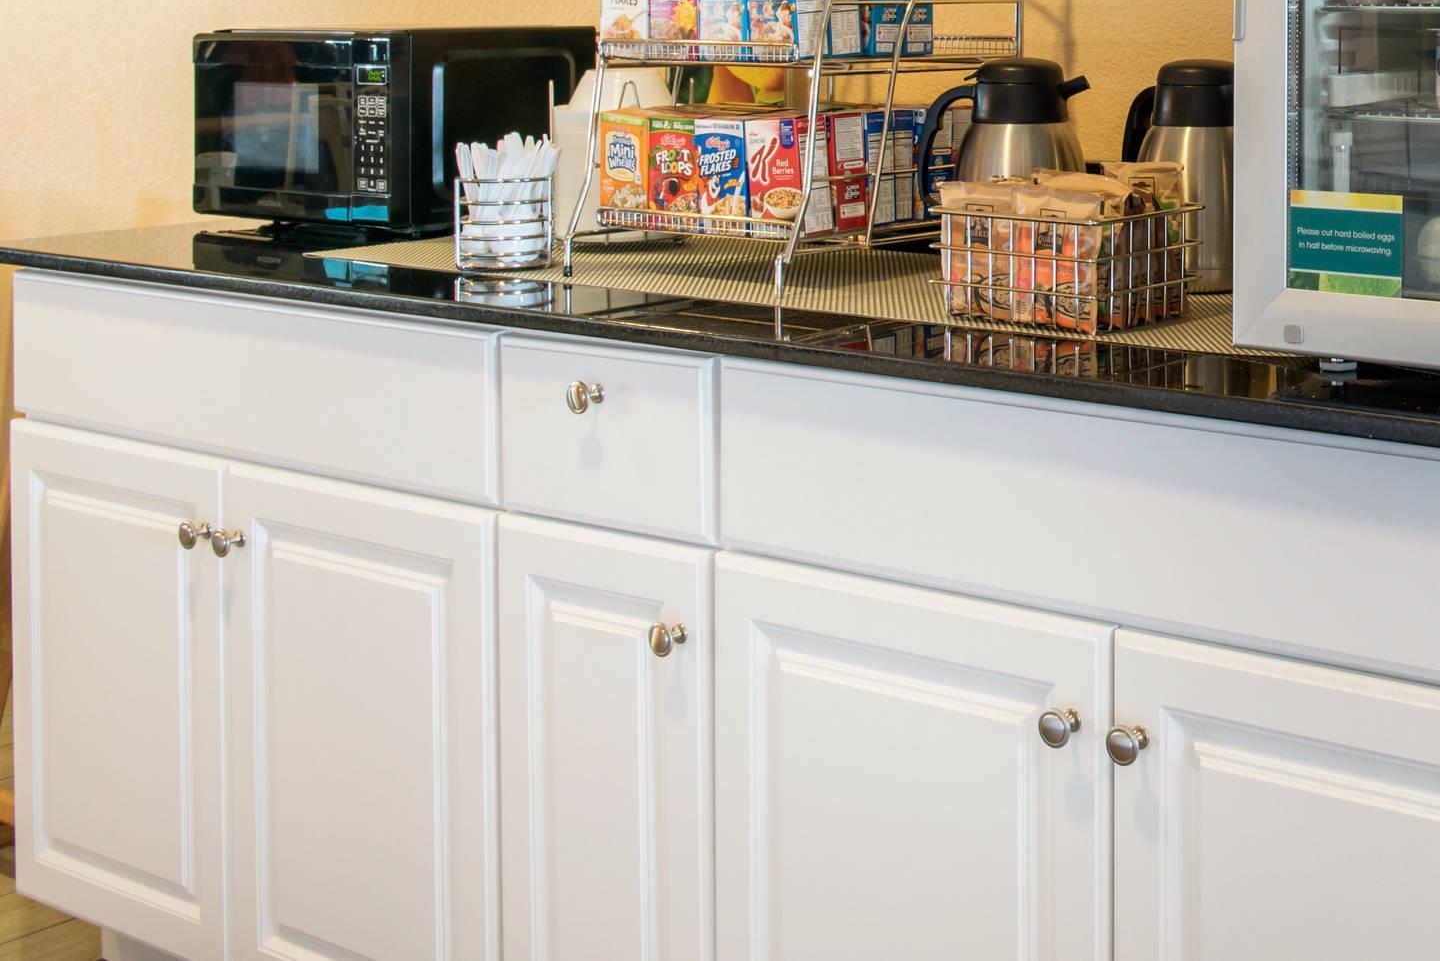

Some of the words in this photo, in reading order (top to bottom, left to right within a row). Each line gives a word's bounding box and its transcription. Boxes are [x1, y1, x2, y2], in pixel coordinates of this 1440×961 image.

[610, 142, 634, 159] Mini
[700, 149, 736, 166] FROSTED
[608, 156, 636, 172] Wheats
[700, 160, 731, 176] FLAKES
[1296, 226, 1320, 236] Please
[1321, 229, 1333, 237] cut
[1334, 229, 1351, 238] hard
[1353, 230, 1375, 240] boiled
[1376, 234, 1395, 242] eggs
[1306, 241, 1320, 250] half
[1321, 243, 1344, 251] before
[1345, 244, 1393, 257] microwaving.
